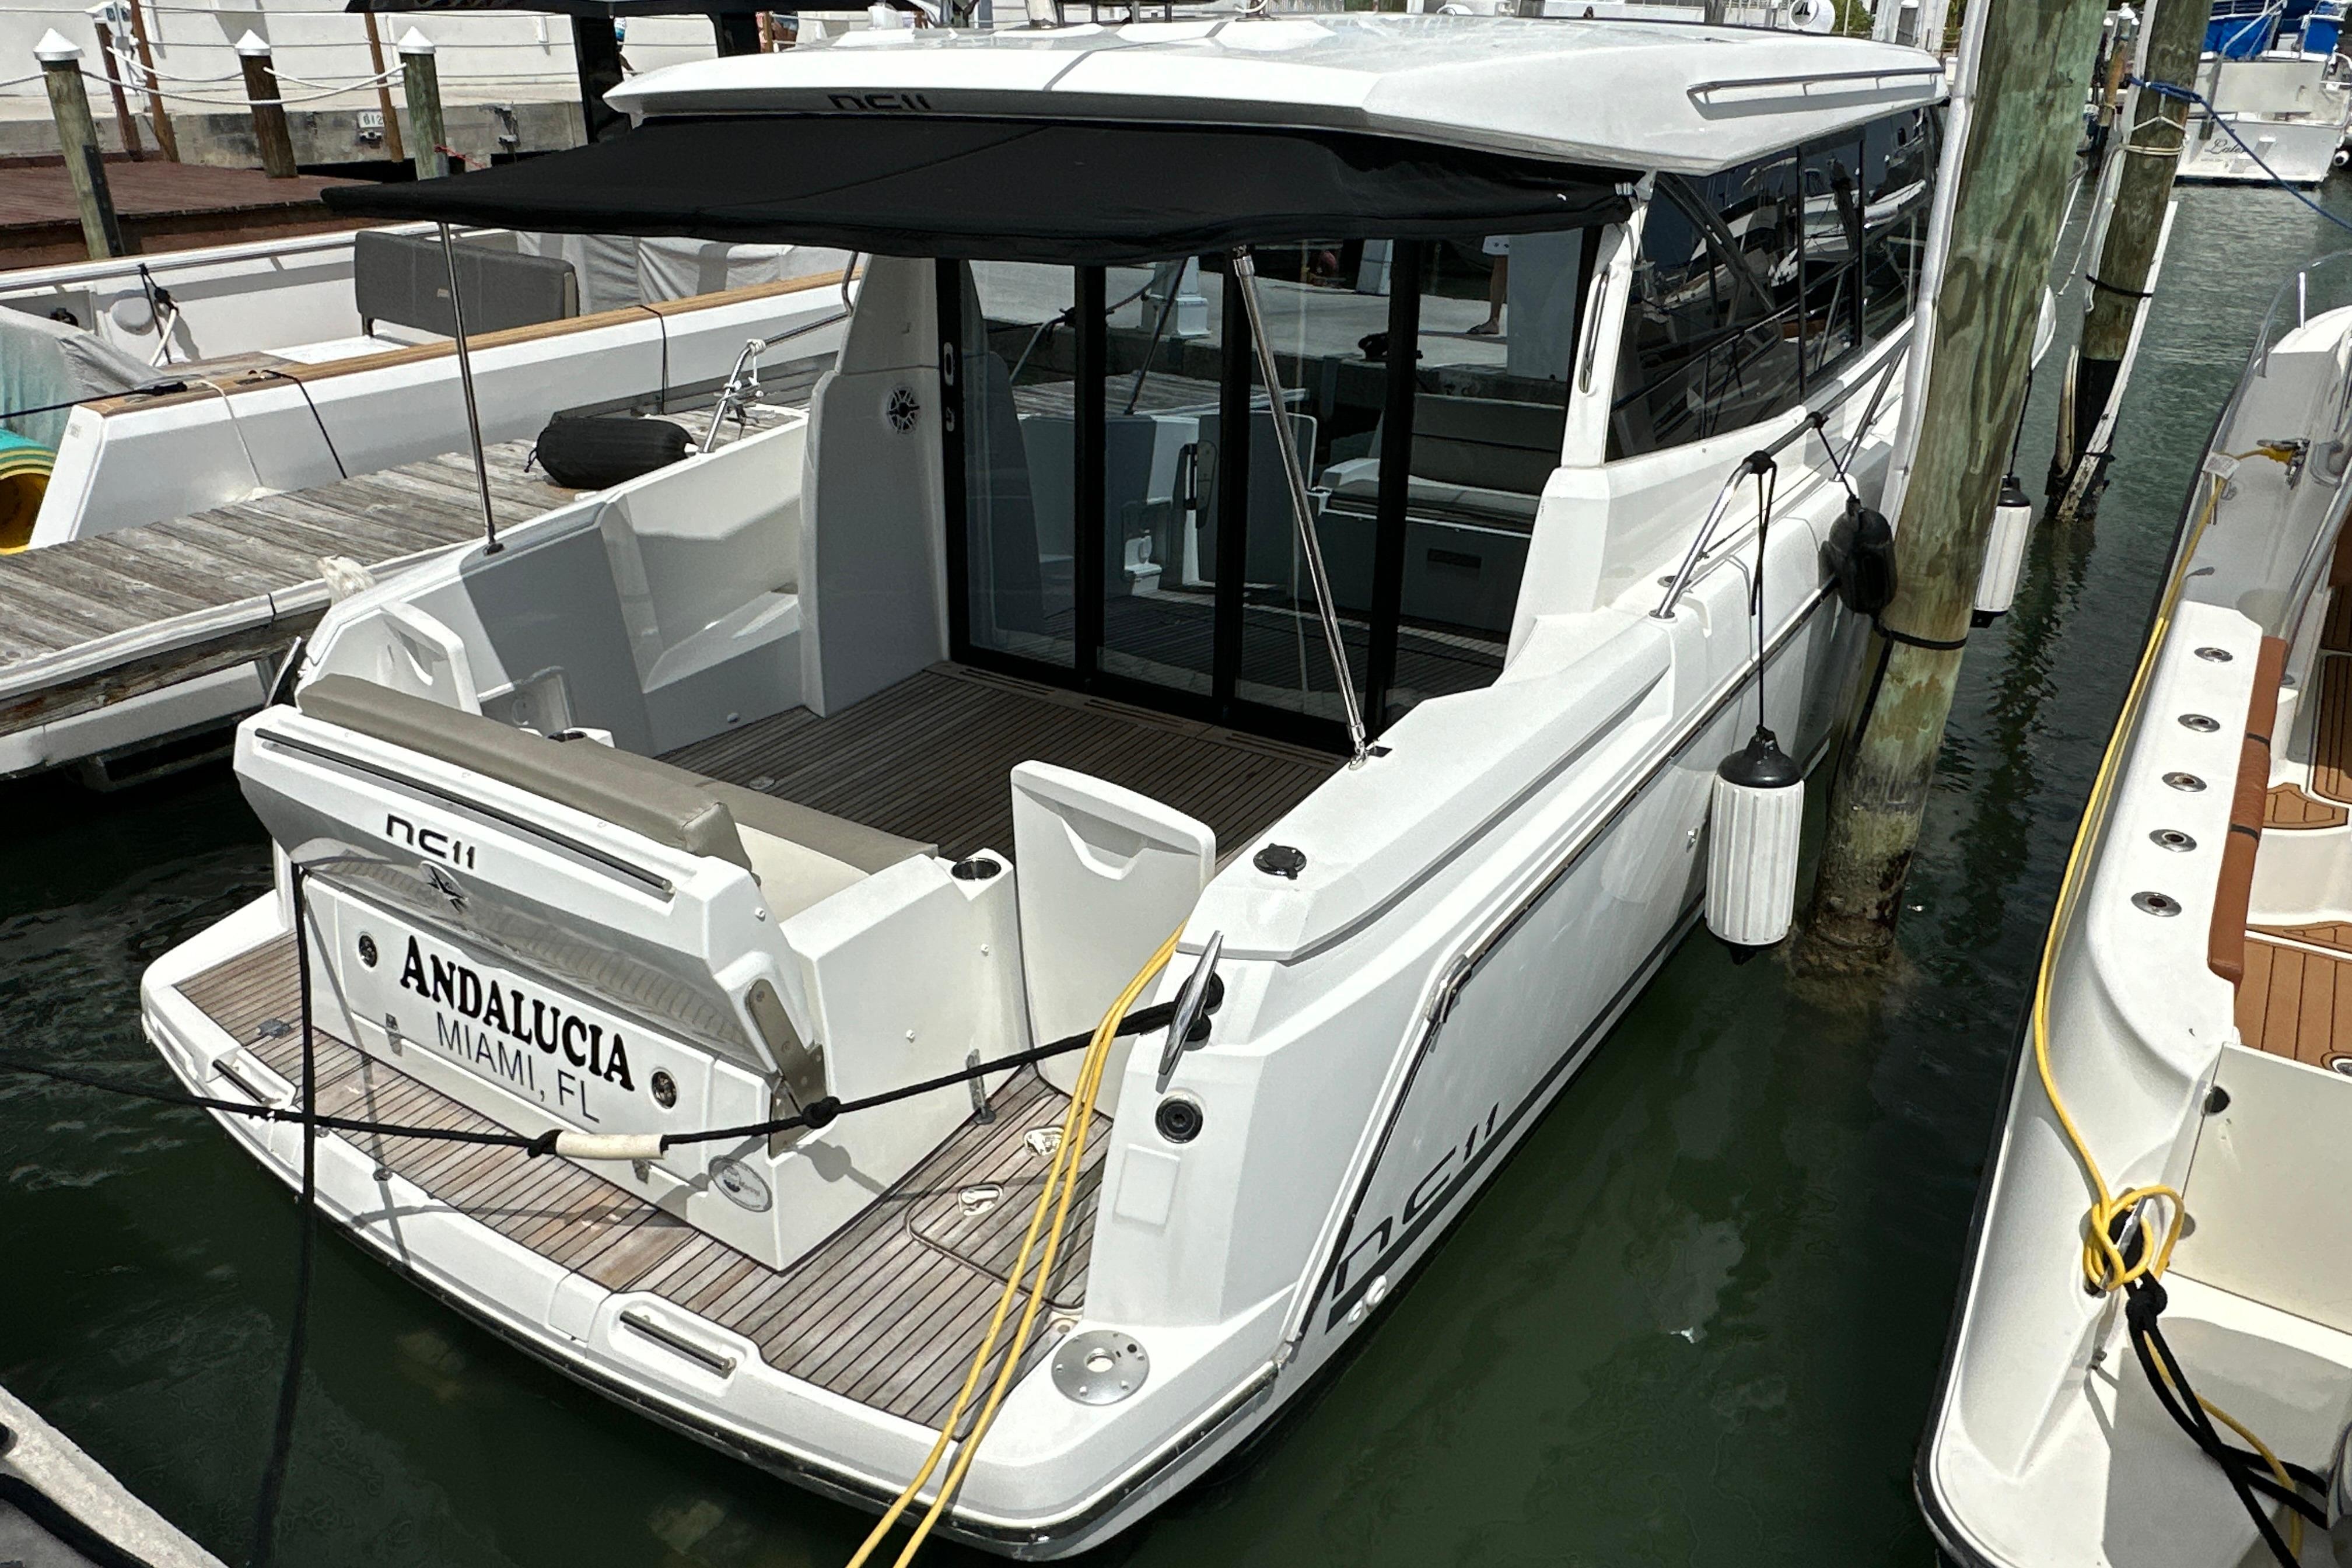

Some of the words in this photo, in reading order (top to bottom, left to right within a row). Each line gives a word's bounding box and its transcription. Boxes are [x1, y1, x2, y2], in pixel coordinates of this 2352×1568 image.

[400, 935, 636, 1092] ANDALUCIA
[436, 1010, 545, 1102] MIAMI,
[558, 1068, 600, 1124] FL
